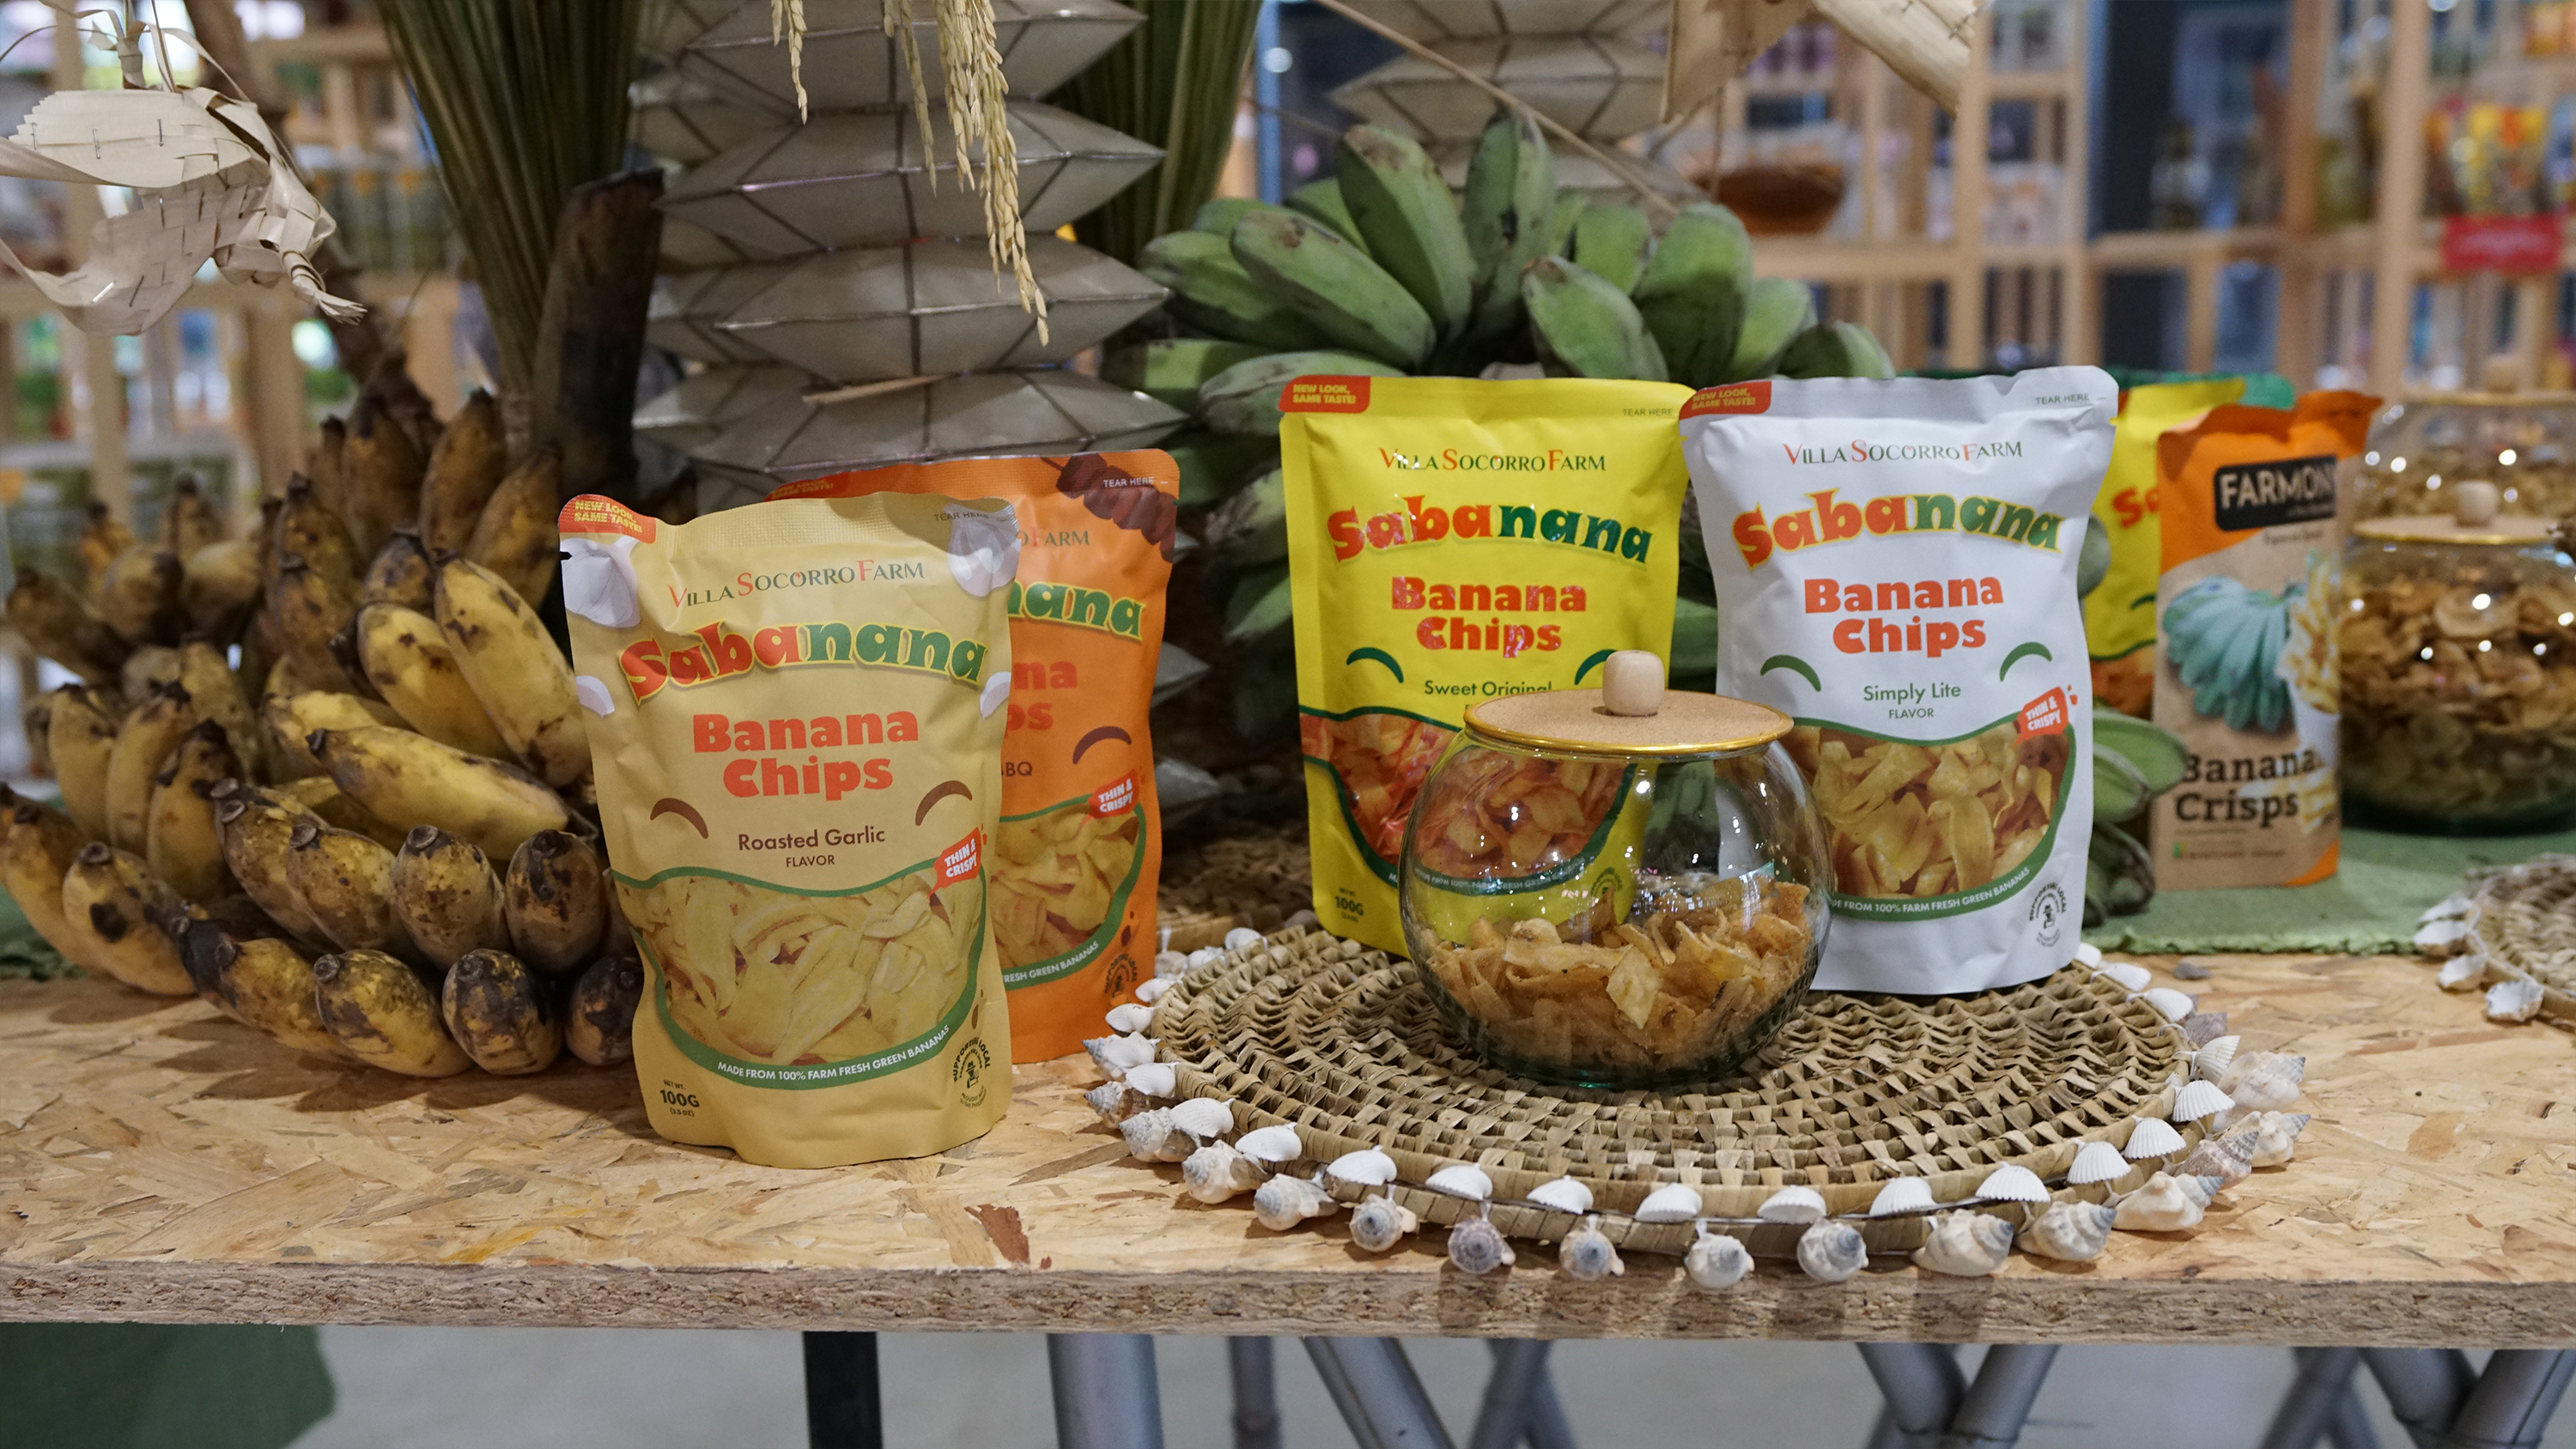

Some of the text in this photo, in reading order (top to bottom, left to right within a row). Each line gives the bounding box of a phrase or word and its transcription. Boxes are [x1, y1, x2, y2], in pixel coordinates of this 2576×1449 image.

[1293, 384, 1317, 393] NEW
[1293, 394, 1356, 404] SAME TASTE!
[1692, 391, 1717, 402] NEW
[2035, 393, 2089, 405] TEAR HERE
[1623, 408, 1673, 416] TEAR HERE
[1692, 397, 1756, 410] SAME TASTE!
[1443, 448, 1546, 471] SOCORRO
[1547, 449, 1607, 471] FARM
[1782, 439, 2023, 465] VILLA SOCORRO FARM
[1103, 476, 1155, 488] TEAR HERE
[574, 500, 604, 511] NEW
[574, 512, 608, 523] SAME
[933, 512, 960, 522] TEAR
[1327, 494, 1654, 564] Sabanana
[1732, 487, 2068, 573] Sabanana
[667, 559, 925, 608] VILLA SOCORRO FARM
[1391, 576, 1588, 612] Banana
[1804, 576, 2005, 614] Banana
[1416, 615, 1562, 658] Chips
[1832, 615, 1987, 658] Chips
[618, 619, 989, 706] Sabanana
[1425, 680, 1477, 695] Sweet
[1863, 682, 1962, 706] Simply Lite
[1888, 707, 1935, 719] FLAVOR
[2026, 695, 2058, 720] THIN &
[2027, 709, 2062, 731] CRISPY
[692, 709, 919, 753] Banana
[723, 755, 894, 801] Chips
[1001, 761, 1033, 777] BQ
[1098, 778, 1133, 803] THIN &
[1099, 791, 1133, 813] CRISPY
[2175, 790, 2300, 829] Crisps
[738, 825, 885, 852] Roasted Garlic
[785, 854, 835, 869] FLAVOR
[944, 838, 976, 867] THIN &
[945, 852, 977, 877] CRISPY
[1844, 900, 1873, 912] FROM
[1875, 903, 1901, 912] 100%
[1902, 902, 1930, 912] FARM
[1931, 898, 1960, 911] FRESH
[1963, 889, 1993, 906] GREEN
[1993, 867, 2030, 897] BANANAS
[1335, 895, 1364, 916] 100G
[1001, 941, 1099, 983] RESH GREEN BANANAS
[718, 1024, 950, 1081] MADE FROM 100% FARM FRESH GREEN BANANAS
[978, 1040, 991, 1069] LOCAL
[660, 1089, 700, 1107] 100G
